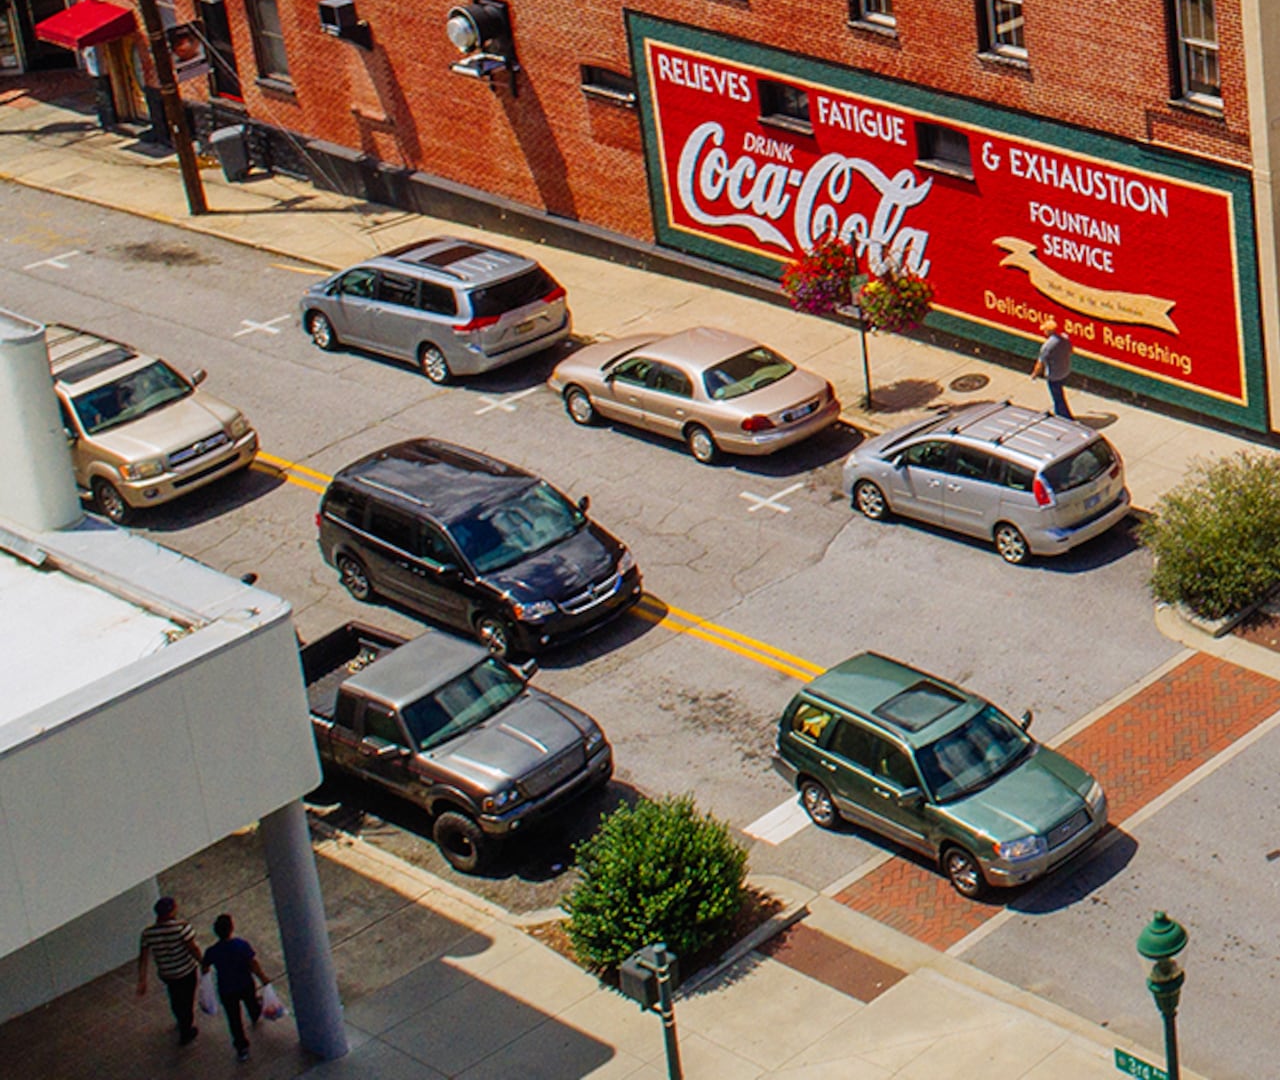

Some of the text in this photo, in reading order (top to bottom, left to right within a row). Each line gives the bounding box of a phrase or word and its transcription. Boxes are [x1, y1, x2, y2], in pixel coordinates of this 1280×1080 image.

[657, 53, 1169, 218] RELIEVES FATIGUE & EXHAUSTION
[743, 131, 795, 163] DRINK
[1029, 201, 1121, 246] FOUNTAIN
[1042, 233, 1115, 274] SERVICE
[1064, 319, 1095, 341] and
[1102, 325, 1192, 375] Refreshing
[1128, 1057, 1150, 1080] 3rd
